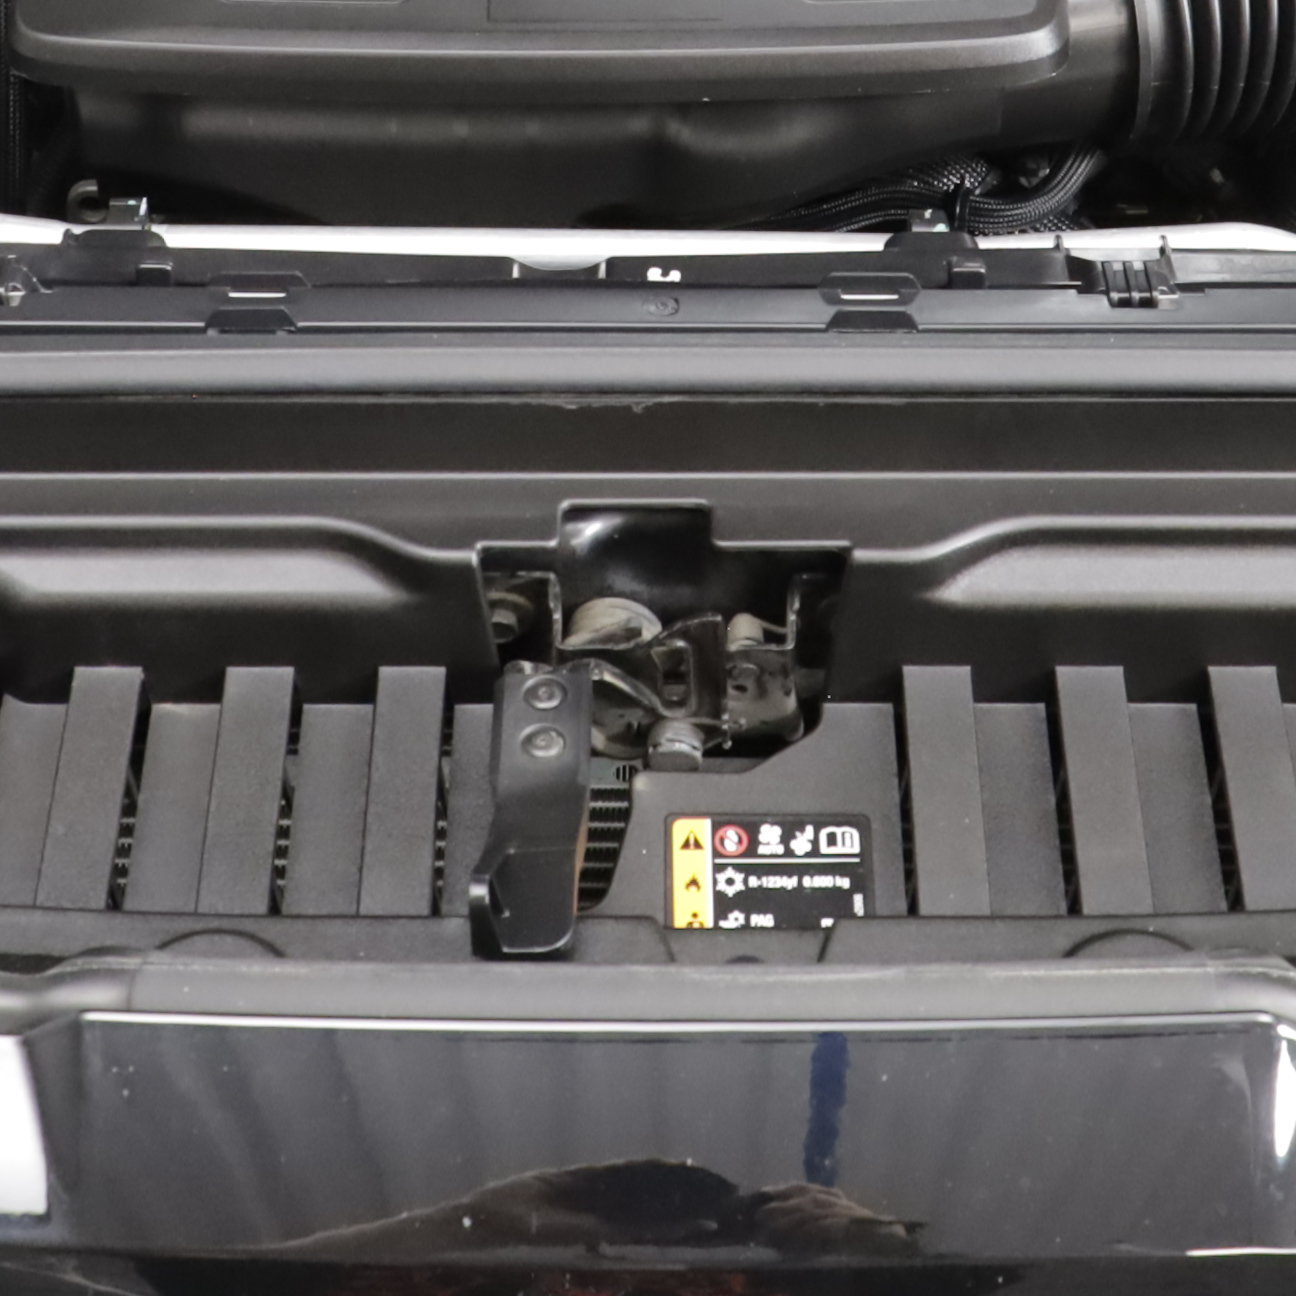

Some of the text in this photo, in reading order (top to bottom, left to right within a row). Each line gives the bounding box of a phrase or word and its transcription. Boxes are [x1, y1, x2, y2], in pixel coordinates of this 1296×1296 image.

[747, 875, 799, 890] R-1234yf
[835, 875, 851, 890] kg
[749, 913, 775, 928] PAG
